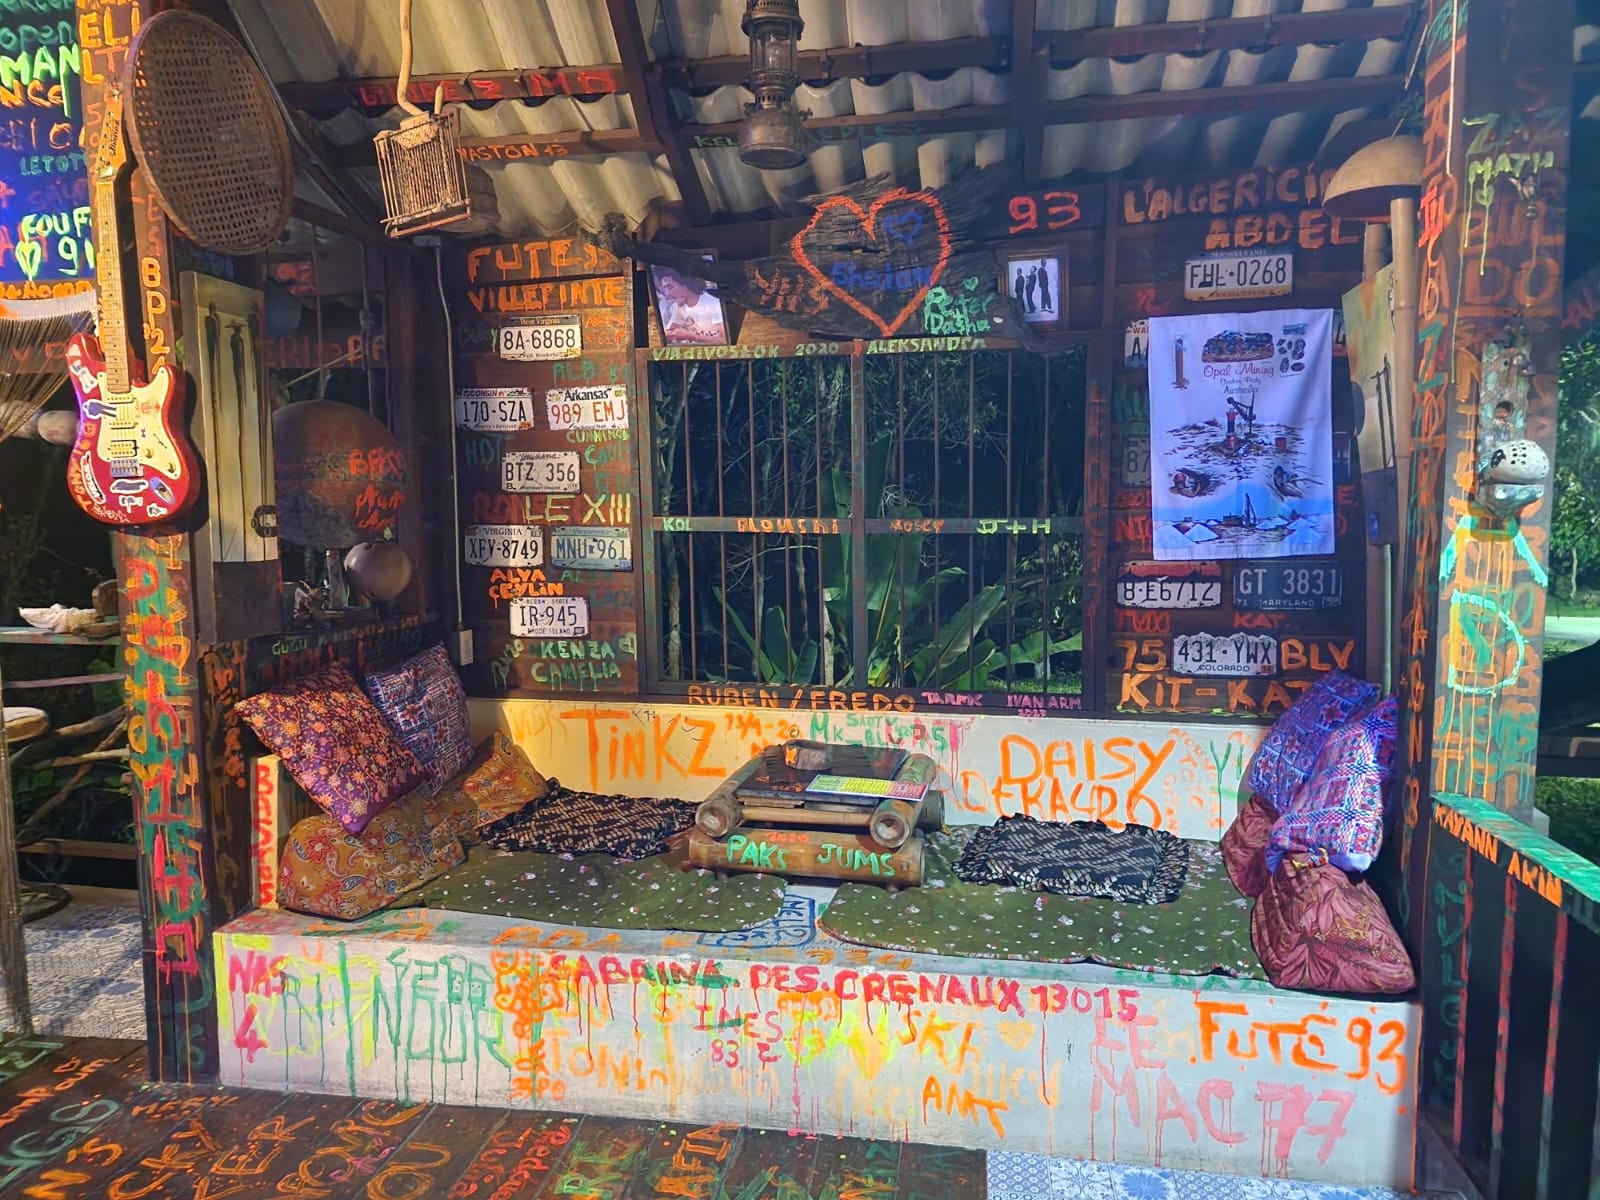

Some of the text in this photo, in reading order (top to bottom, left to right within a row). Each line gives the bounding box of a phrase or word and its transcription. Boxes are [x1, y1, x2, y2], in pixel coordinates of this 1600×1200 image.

[1009, 191, 1080, 233] 93
[1203, 362, 1274, 380] Opal Mining
[463, 400, 527, 422] 170-SZA
[551, 400, 625, 424] 989 EMJ
[505, 462, 576, 482] BTZ 356
[469, 539, 539, 560] XFV-8749
[1240, 568, 1337, 594] GT 3831
[520, 606, 577, 626] IR-945
[687, 685, 779, 709] RUBEN
[810, 690, 916, 712] FREDO
[1000, 734, 1176, 796] DAISY
[1030, 985, 1141, 1022] 13015
[1344, 1012, 1407, 1095] 93
